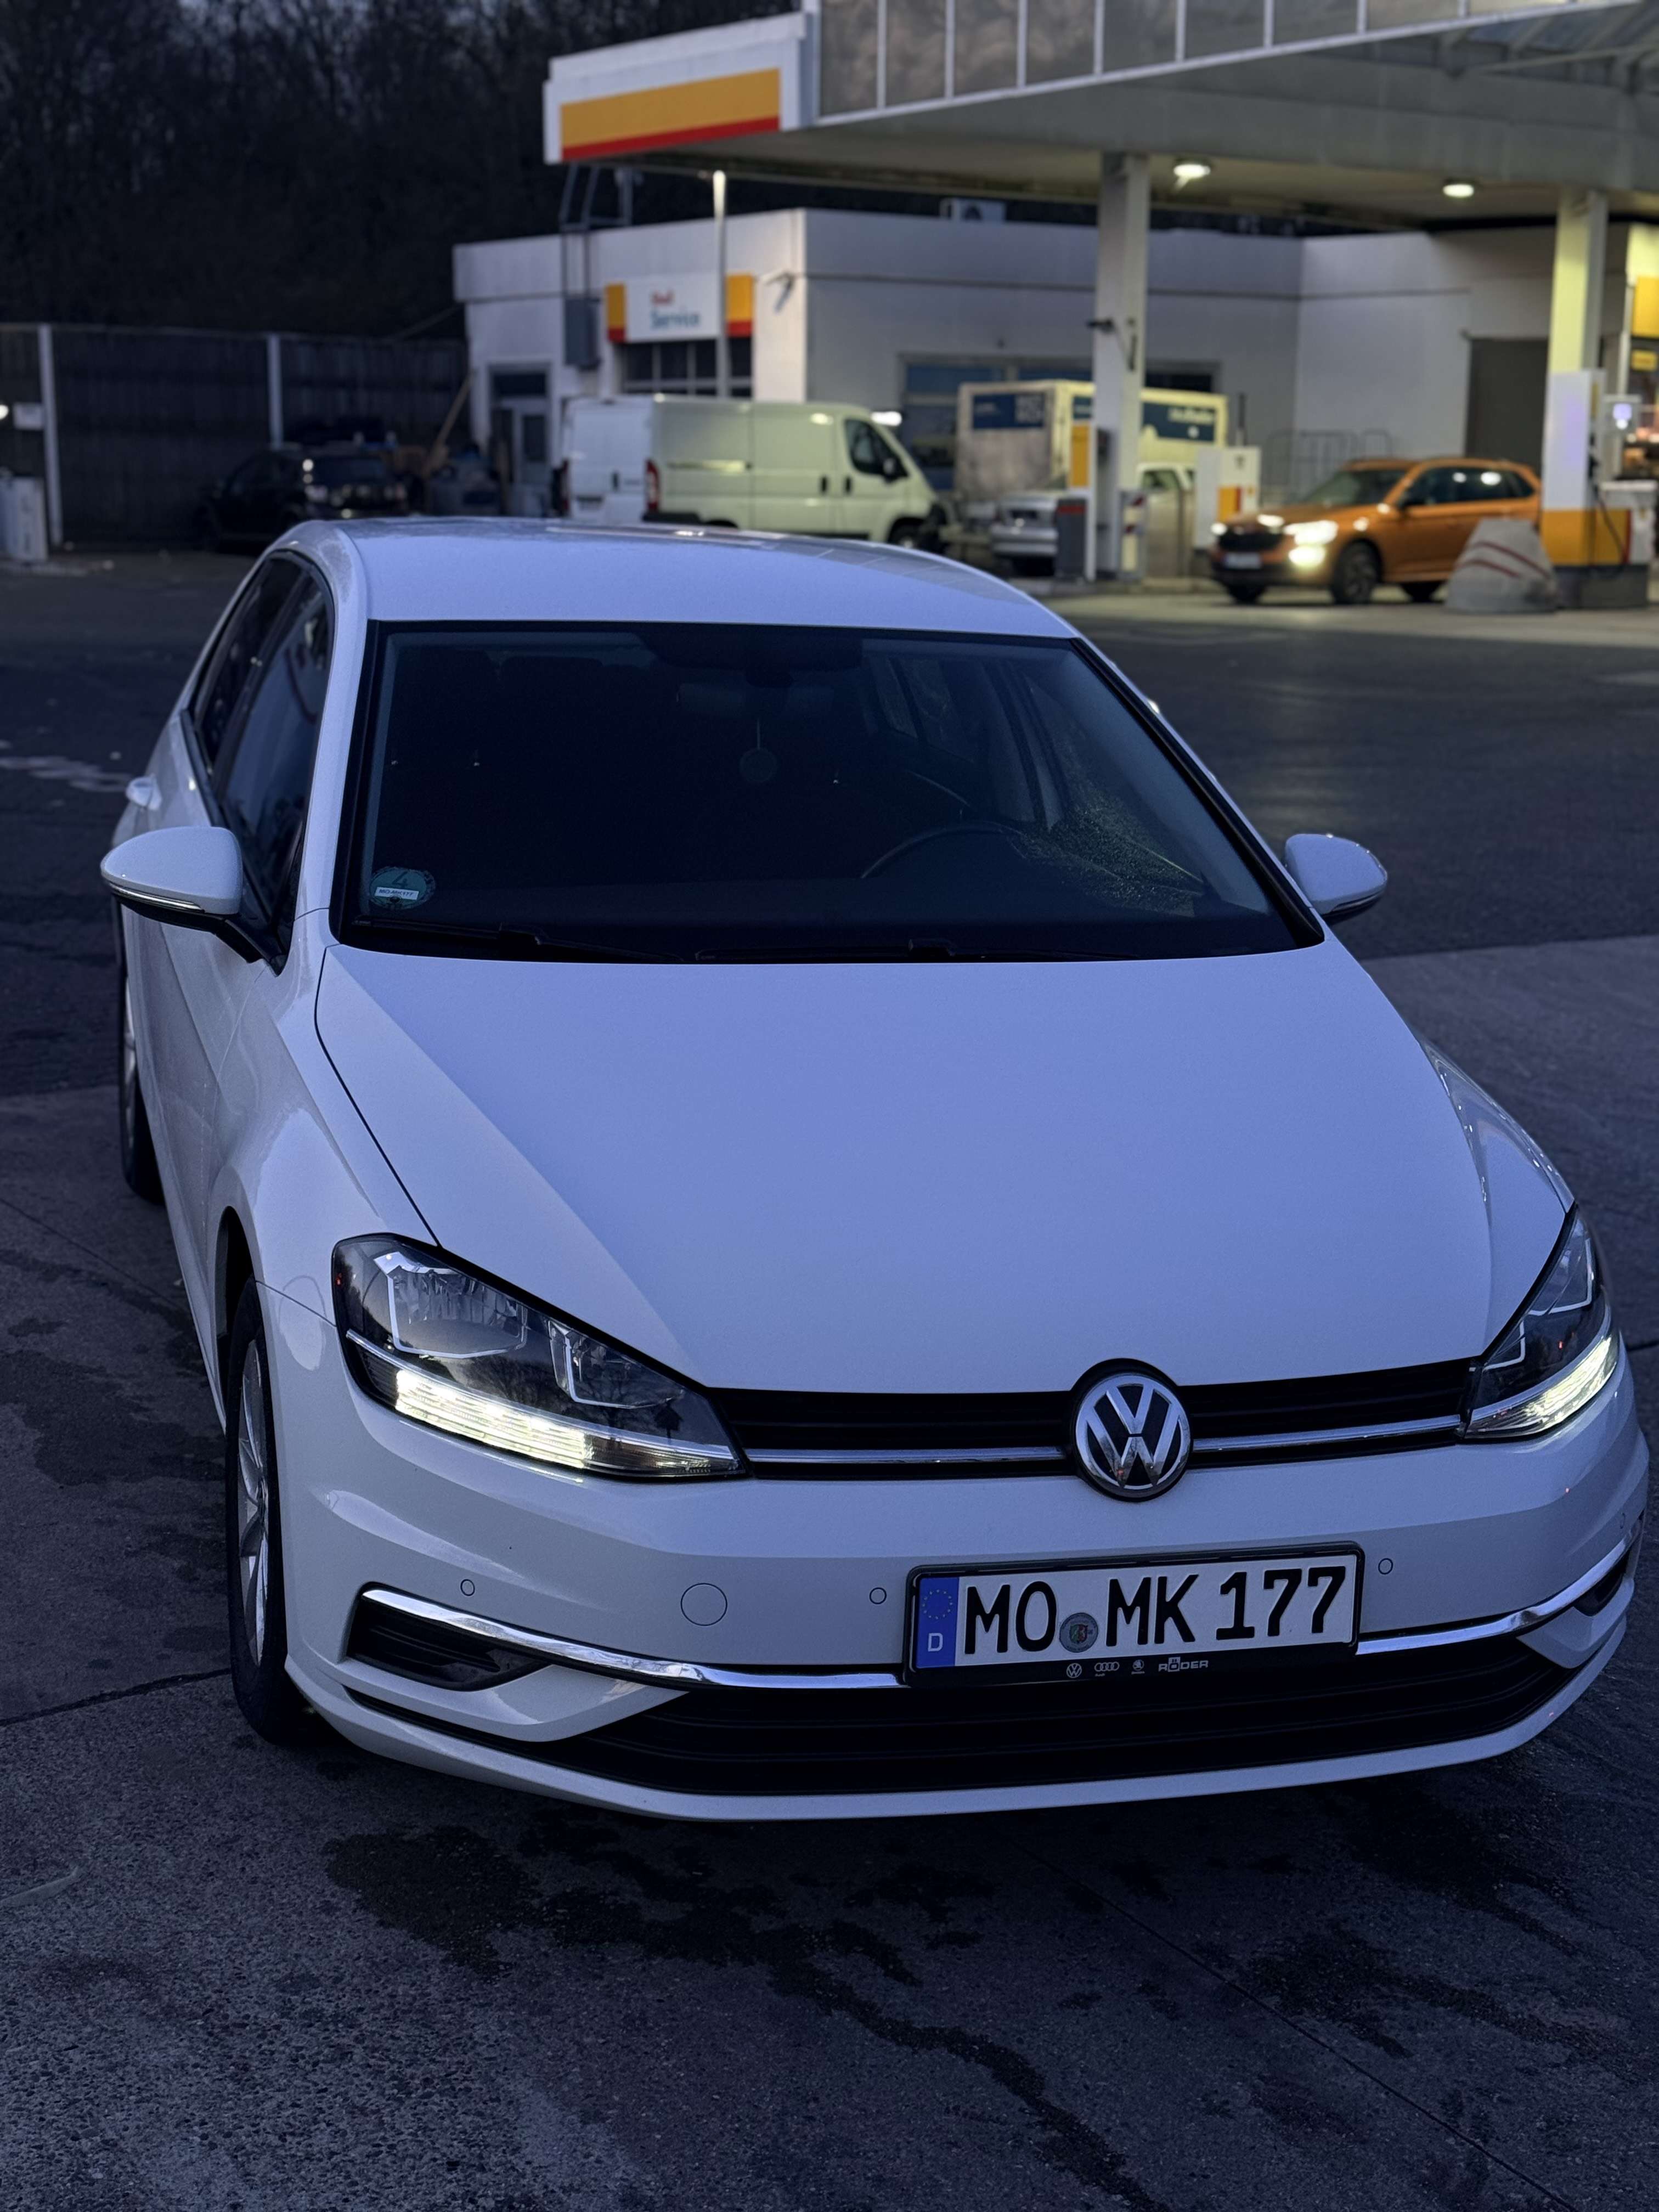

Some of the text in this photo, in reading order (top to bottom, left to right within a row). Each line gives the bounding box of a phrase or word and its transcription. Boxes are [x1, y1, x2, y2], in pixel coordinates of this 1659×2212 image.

[964, 1581, 1057, 1654] MO
[1106, 1575, 1199, 1646] MK
[1216, 1566, 1346, 1640] 177
[928, 1633, 943, 1652] D
